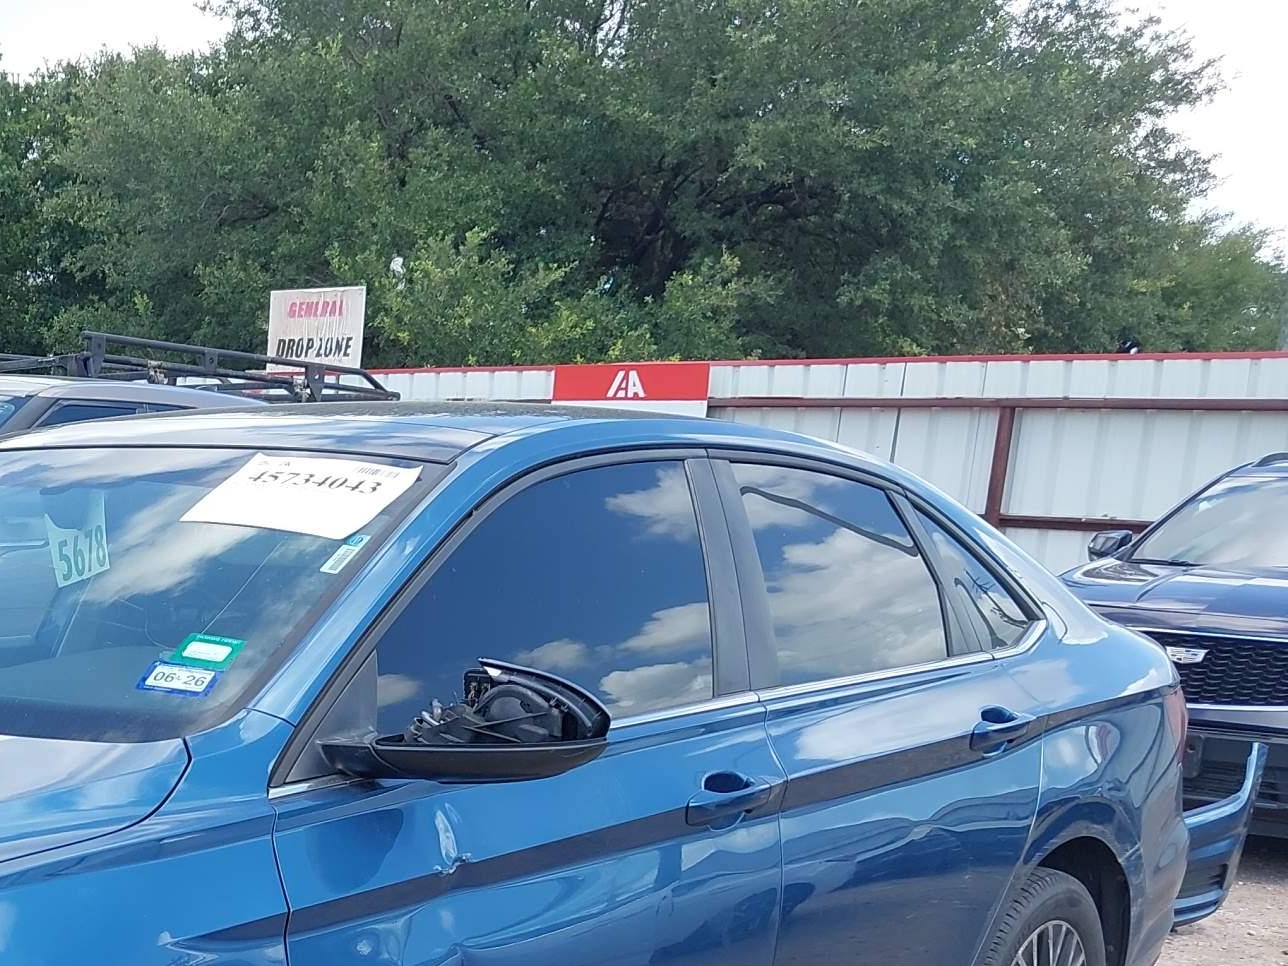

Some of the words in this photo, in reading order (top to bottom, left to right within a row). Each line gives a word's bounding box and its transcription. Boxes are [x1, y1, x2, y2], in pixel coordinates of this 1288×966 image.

[276, 337, 314, 359] DROP
[315, 336, 353, 358] ZONE
[248, 470, 383, 494] 45734043
[57, 525, 107, 581] 5678
[153, 671, 177, 683] 06
[183, 675, 208, 687] 26
